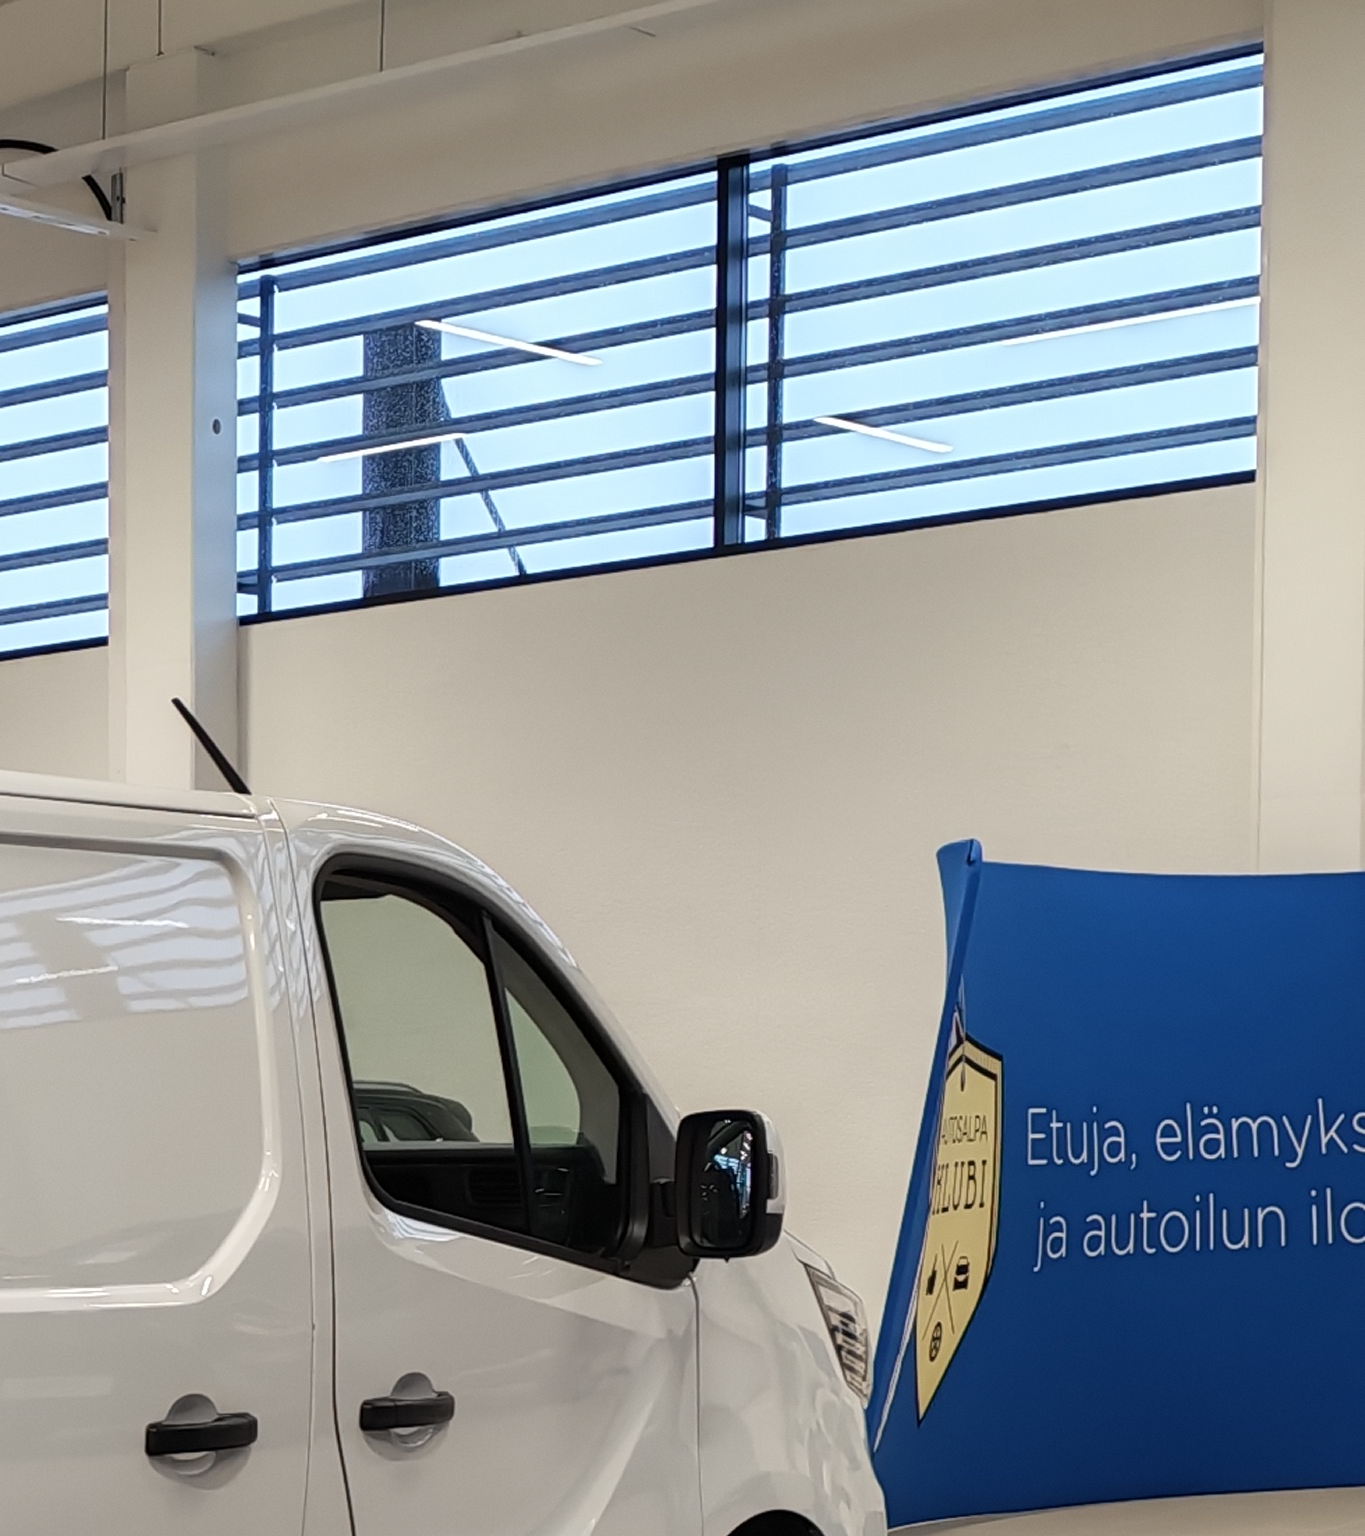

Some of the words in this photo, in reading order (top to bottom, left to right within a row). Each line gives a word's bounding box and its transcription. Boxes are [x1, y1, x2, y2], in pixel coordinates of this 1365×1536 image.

[1026, 1105, 1137, 1177] Etuja,
[1155, 1097, 1365, 1169] elämyks
[931, 1159, 988, 1216] KLUBI
[1032, 1201, 1068, 1273] ja
[1082, 1192, 1287, 1258] autoilun
